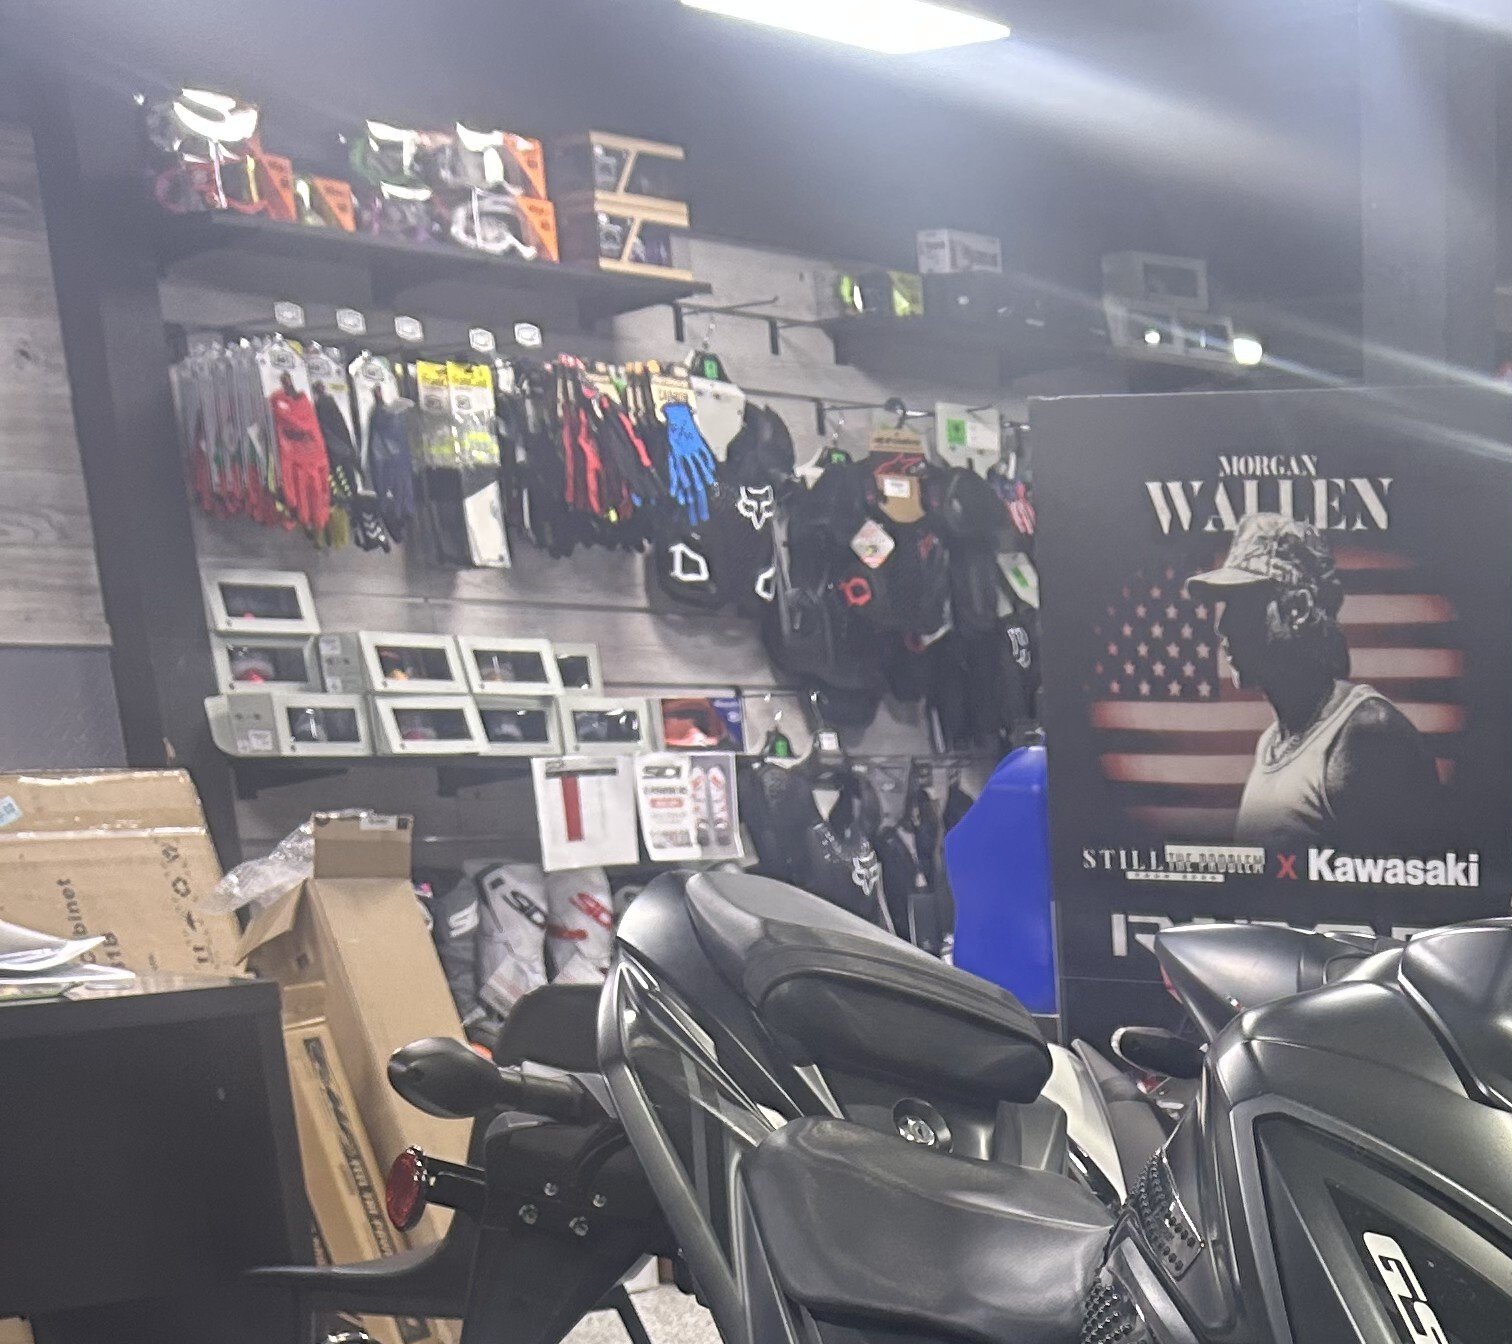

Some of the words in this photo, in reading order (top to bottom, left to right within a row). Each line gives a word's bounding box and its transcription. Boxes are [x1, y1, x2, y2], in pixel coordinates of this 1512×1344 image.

[1219, 454, 1318, 477] MORGAN
[1083, 848, 1164, 871] STILL
[1307, 848, 1480, 887] Kawasaki
